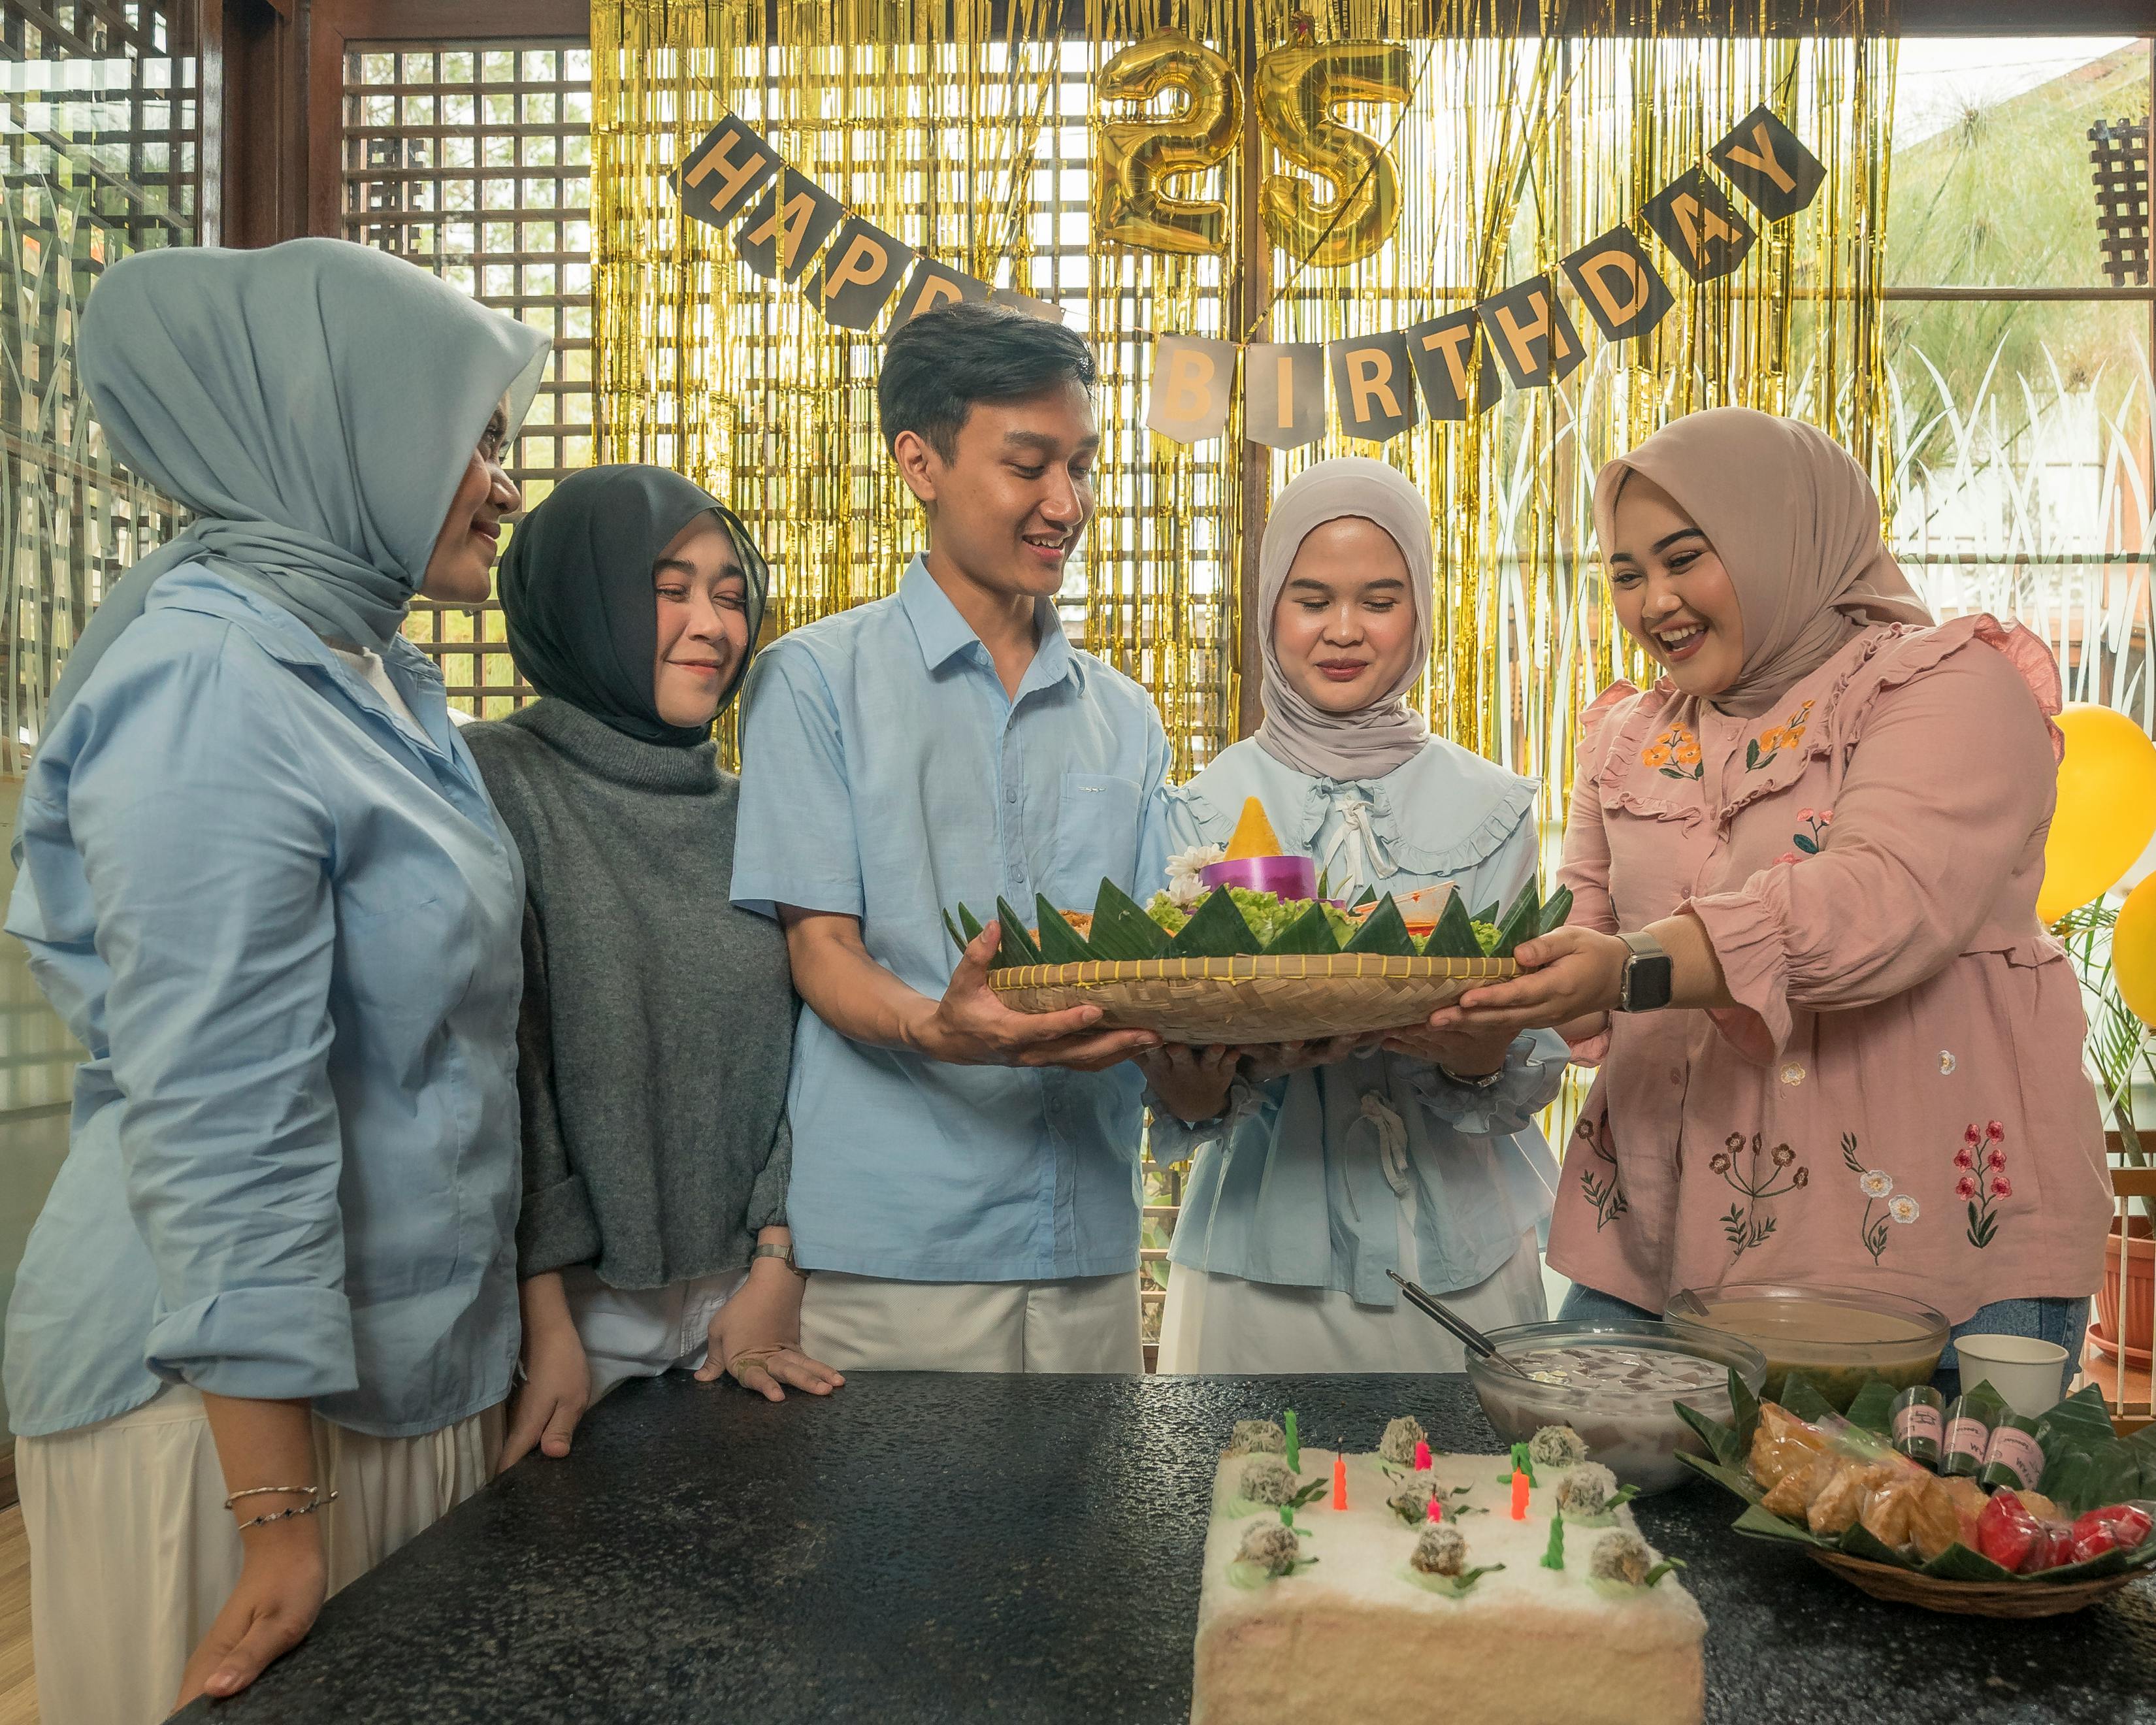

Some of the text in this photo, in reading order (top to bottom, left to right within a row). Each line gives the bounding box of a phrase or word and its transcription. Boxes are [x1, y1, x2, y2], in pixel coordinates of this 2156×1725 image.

[685, 121, 1797, 429] HAPP BIRTHDAY
[1096, 27, 1413, 269] 25
